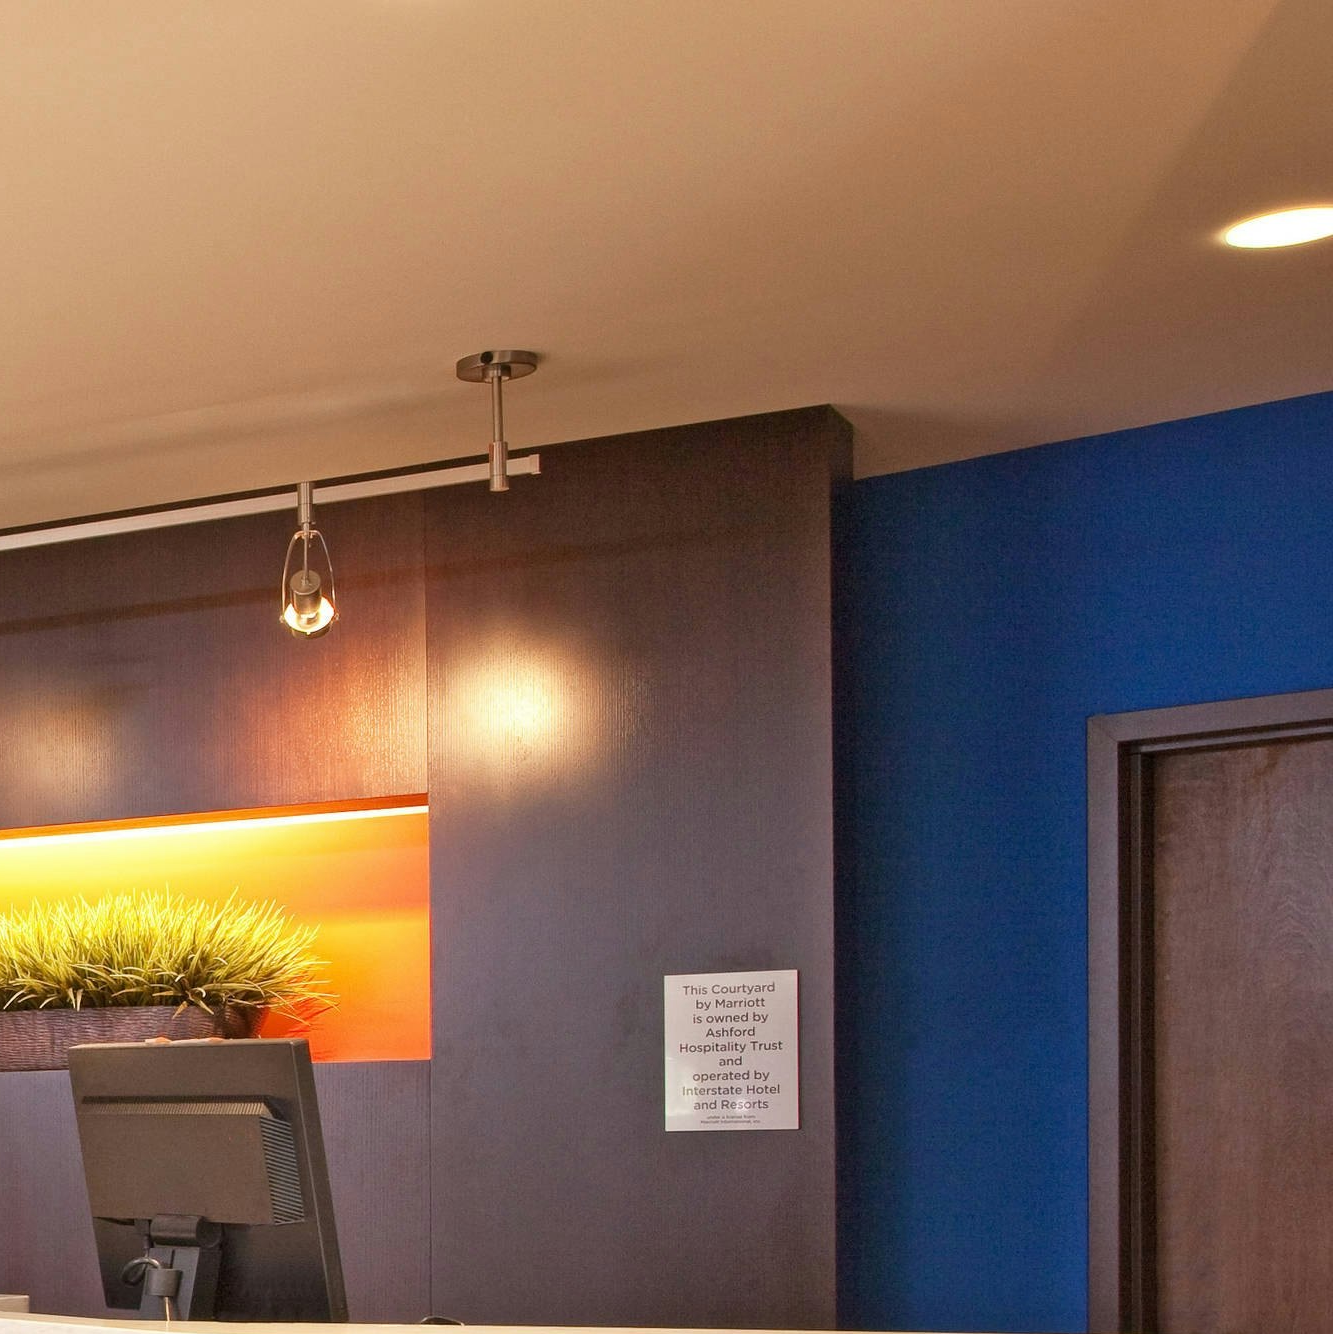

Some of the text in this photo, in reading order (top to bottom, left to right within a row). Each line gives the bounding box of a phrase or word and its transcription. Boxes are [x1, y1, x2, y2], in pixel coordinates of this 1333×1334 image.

[683, 982, 776, 996] This Courtyard
[696, 997, 766, 1011] by Marriott
[693, 1012, 769, 1024] is owned by
[706, 1026, 756, 1038] Ashford
[679, 1040, 783, 1054] Hospitality Trust
[719, 1056, 743, 1067] and
[692, 1070, 770, 1083] operated by
[682, 1084, 781, 1097] Interstate Hotel
[694, 1099, 769, 1111] and Resorts
